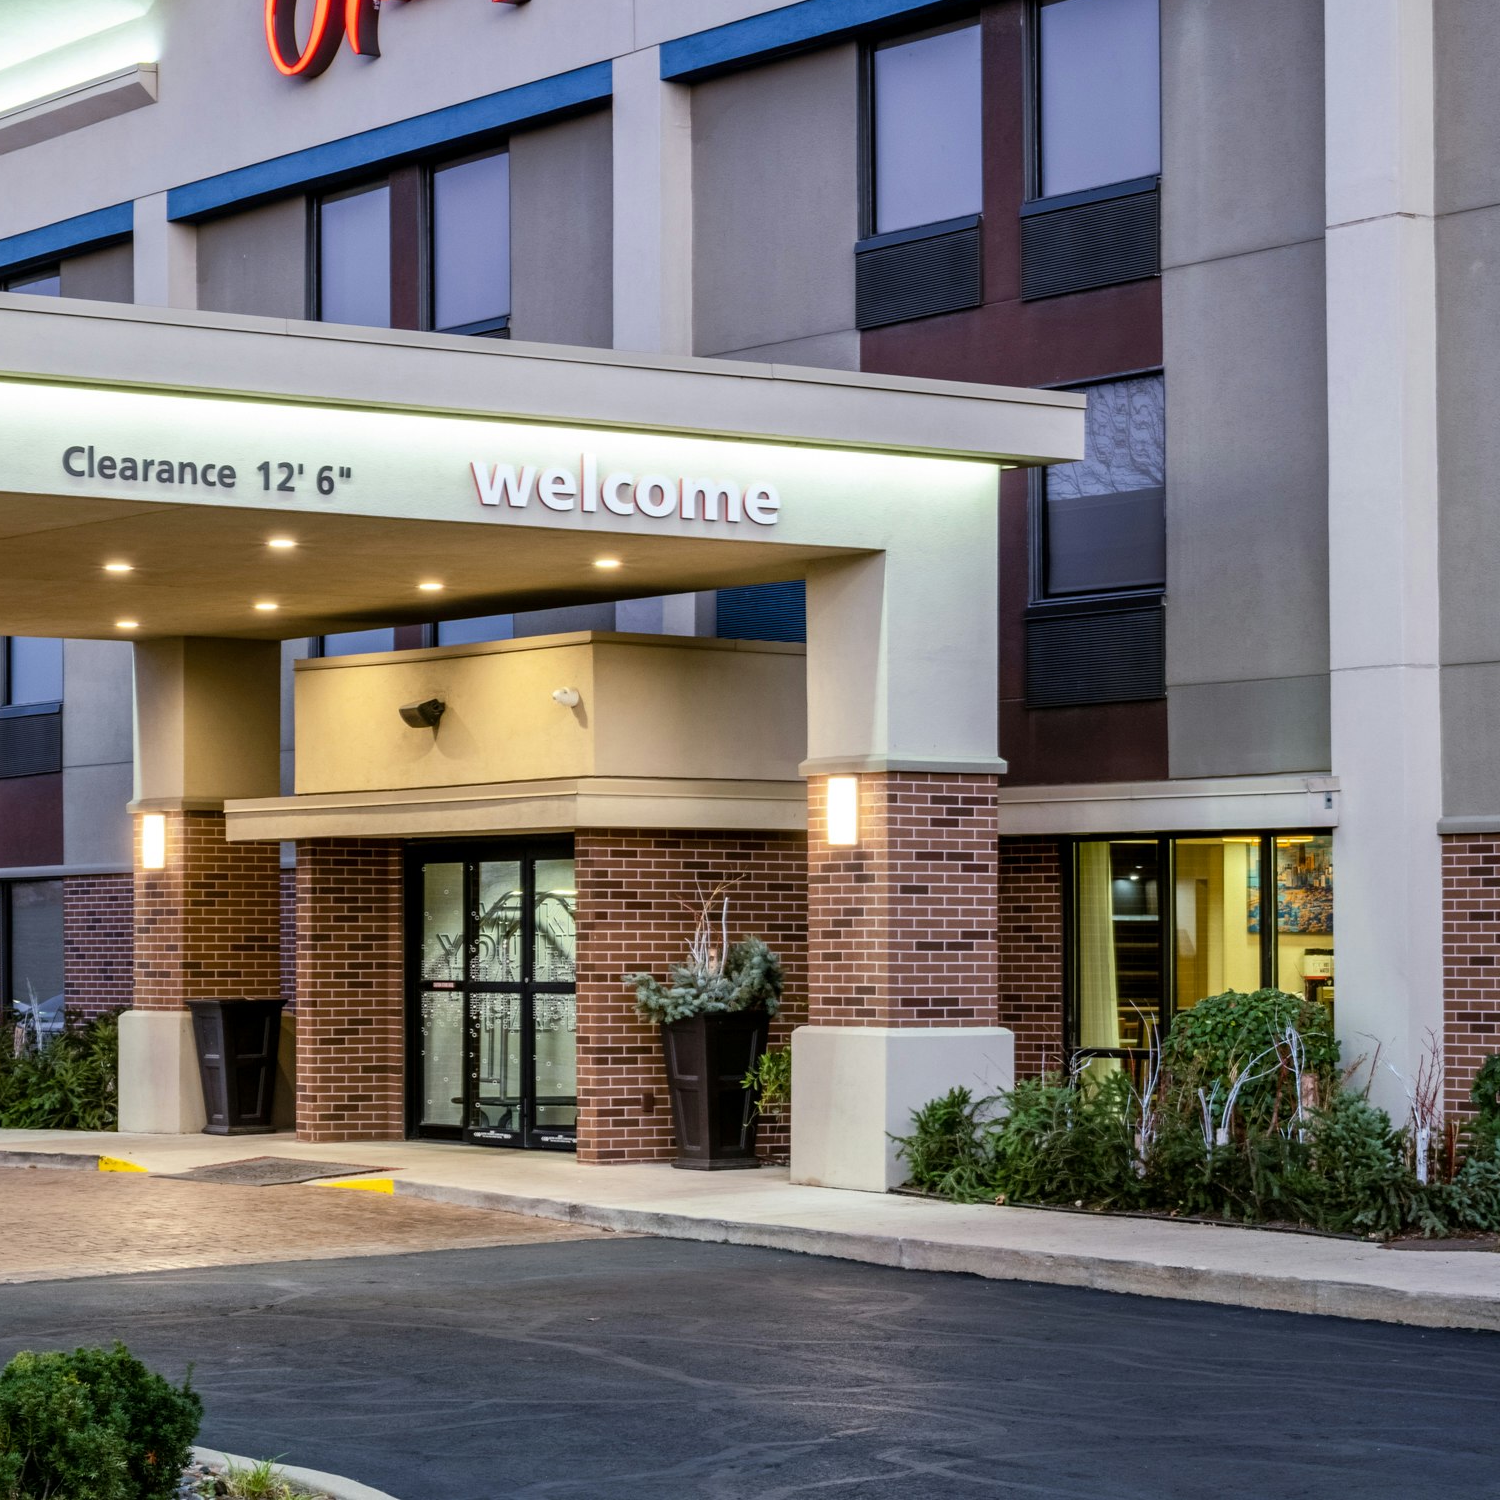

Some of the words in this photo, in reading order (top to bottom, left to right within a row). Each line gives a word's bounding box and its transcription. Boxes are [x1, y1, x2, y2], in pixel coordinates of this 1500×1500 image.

[62, 445, 237, 488] Clearance
[257, 461, 304, 492] 12'
[470, 452, 781, 525] welcome
